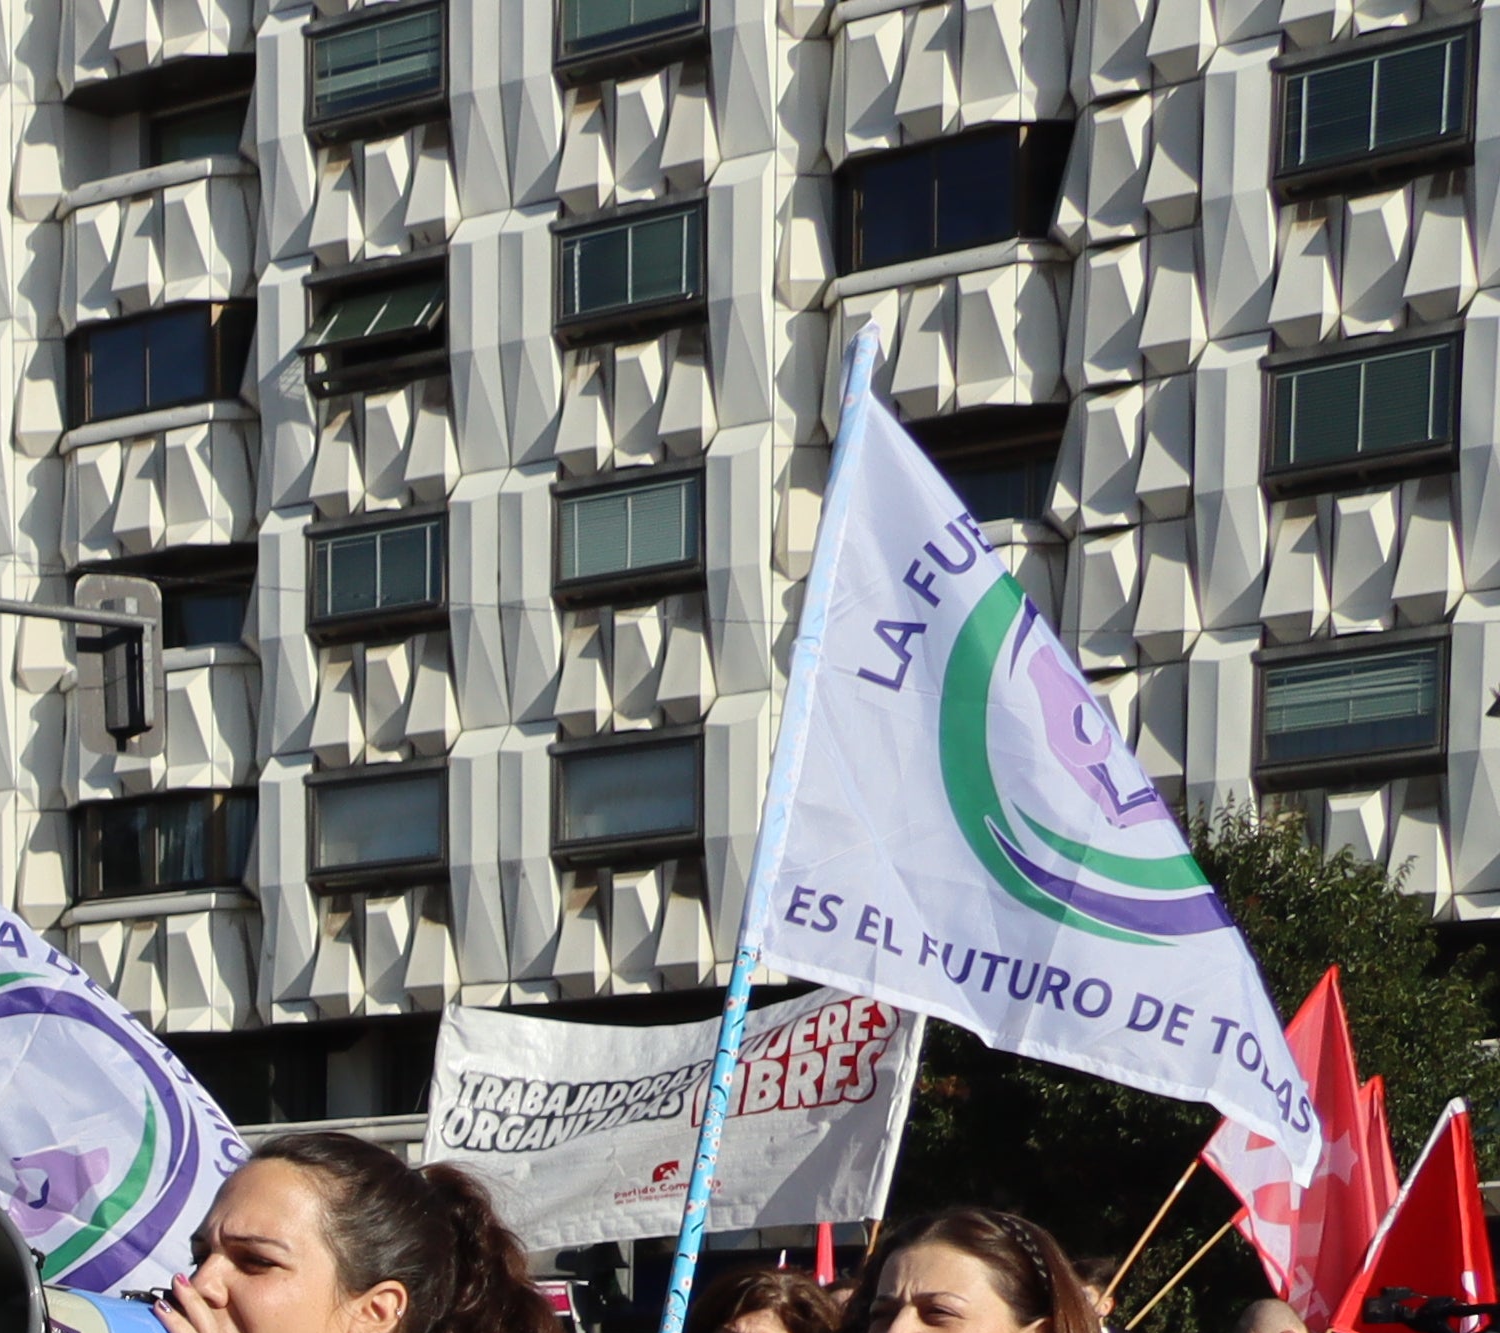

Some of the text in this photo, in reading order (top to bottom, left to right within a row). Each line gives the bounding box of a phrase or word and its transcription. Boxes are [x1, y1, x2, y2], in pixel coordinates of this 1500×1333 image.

[856, 613, 925, 693] LA
[784, 883, 843, 934] ES
[856, 910, 902, 956] EL
[918, 932, 1112, 1018] FUTURO
[1127, 993, 1191, 1047] DE
[735, 998, 902, 1066] UJERES
[441, 1088, 690, 1153] ORGANIZADAS
[458, 1059, 713, 1117] TRABAJADORAS
